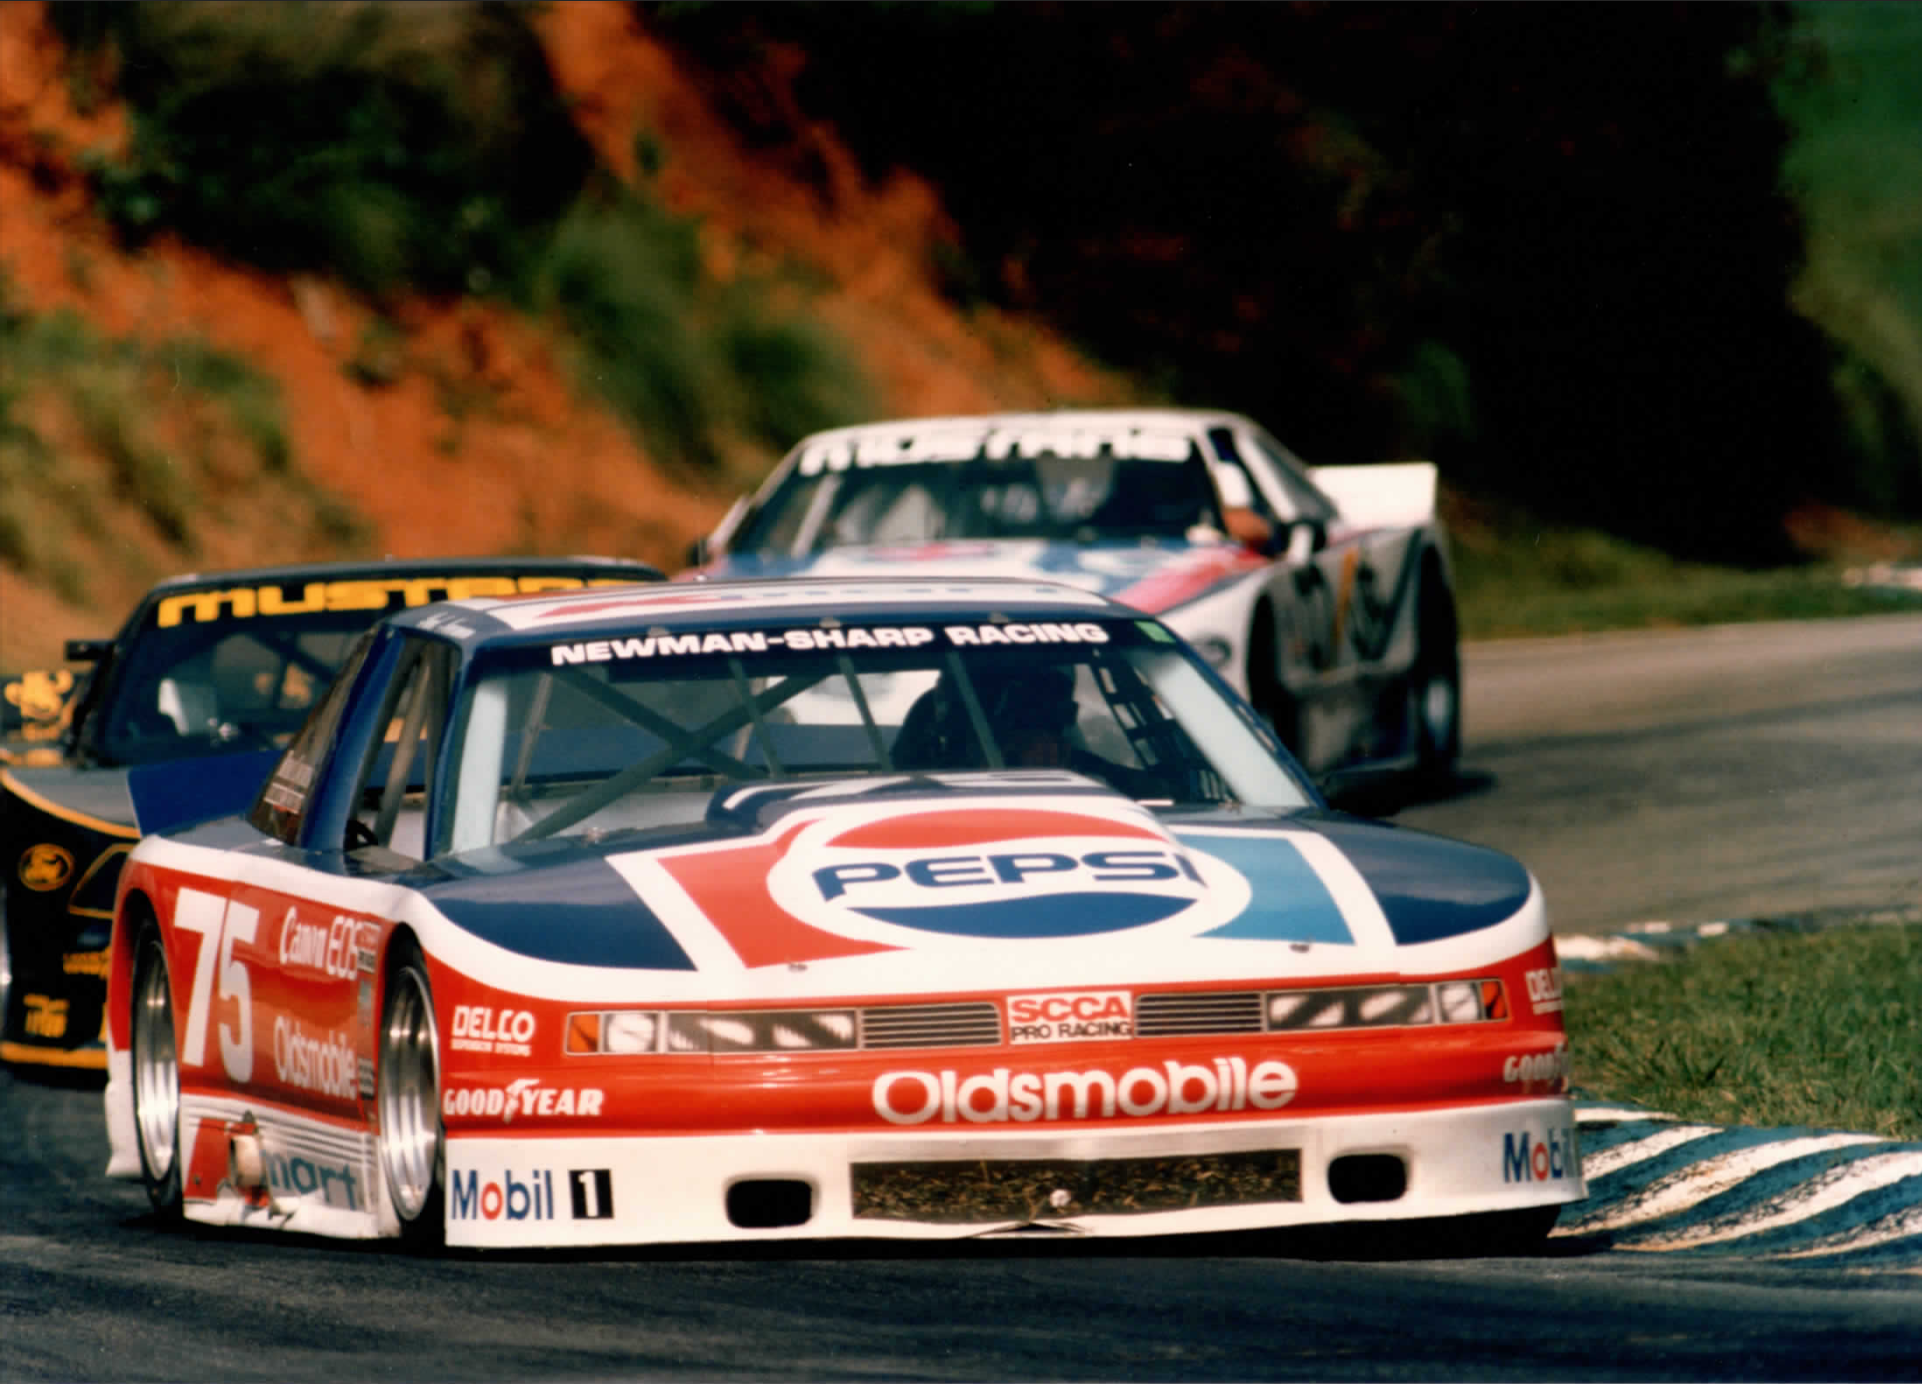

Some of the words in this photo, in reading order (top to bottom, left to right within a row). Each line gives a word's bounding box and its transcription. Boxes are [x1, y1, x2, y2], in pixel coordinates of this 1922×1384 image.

[551, 627, 933, 666] NEWMAN-SHARP
[944, 623, 1110, 646] RACING
[811, 851, 1209, 902] PEPSI
[279, 906, 328, 968] Canon
[327, 915, 362, 981] EOS
[173, 887, 260, 1083] 75
[1011, 996, 1129, 1023] SCCA
[452, 1005, 536, 1042] DELCO
[1011, 1024, 1051, 1041] PRO
[1058, 1021, 1134, 1038] RACING
[273, 1015, 358, 1101] Oldsmobile
[443, 1080, 605, 1122] GOODYEAR
[872, 1057, 1299, 1125] Oldsmobile
[452, 1168, 554, 1220] Mobil
[575, 1170, 602, 1219] 1
